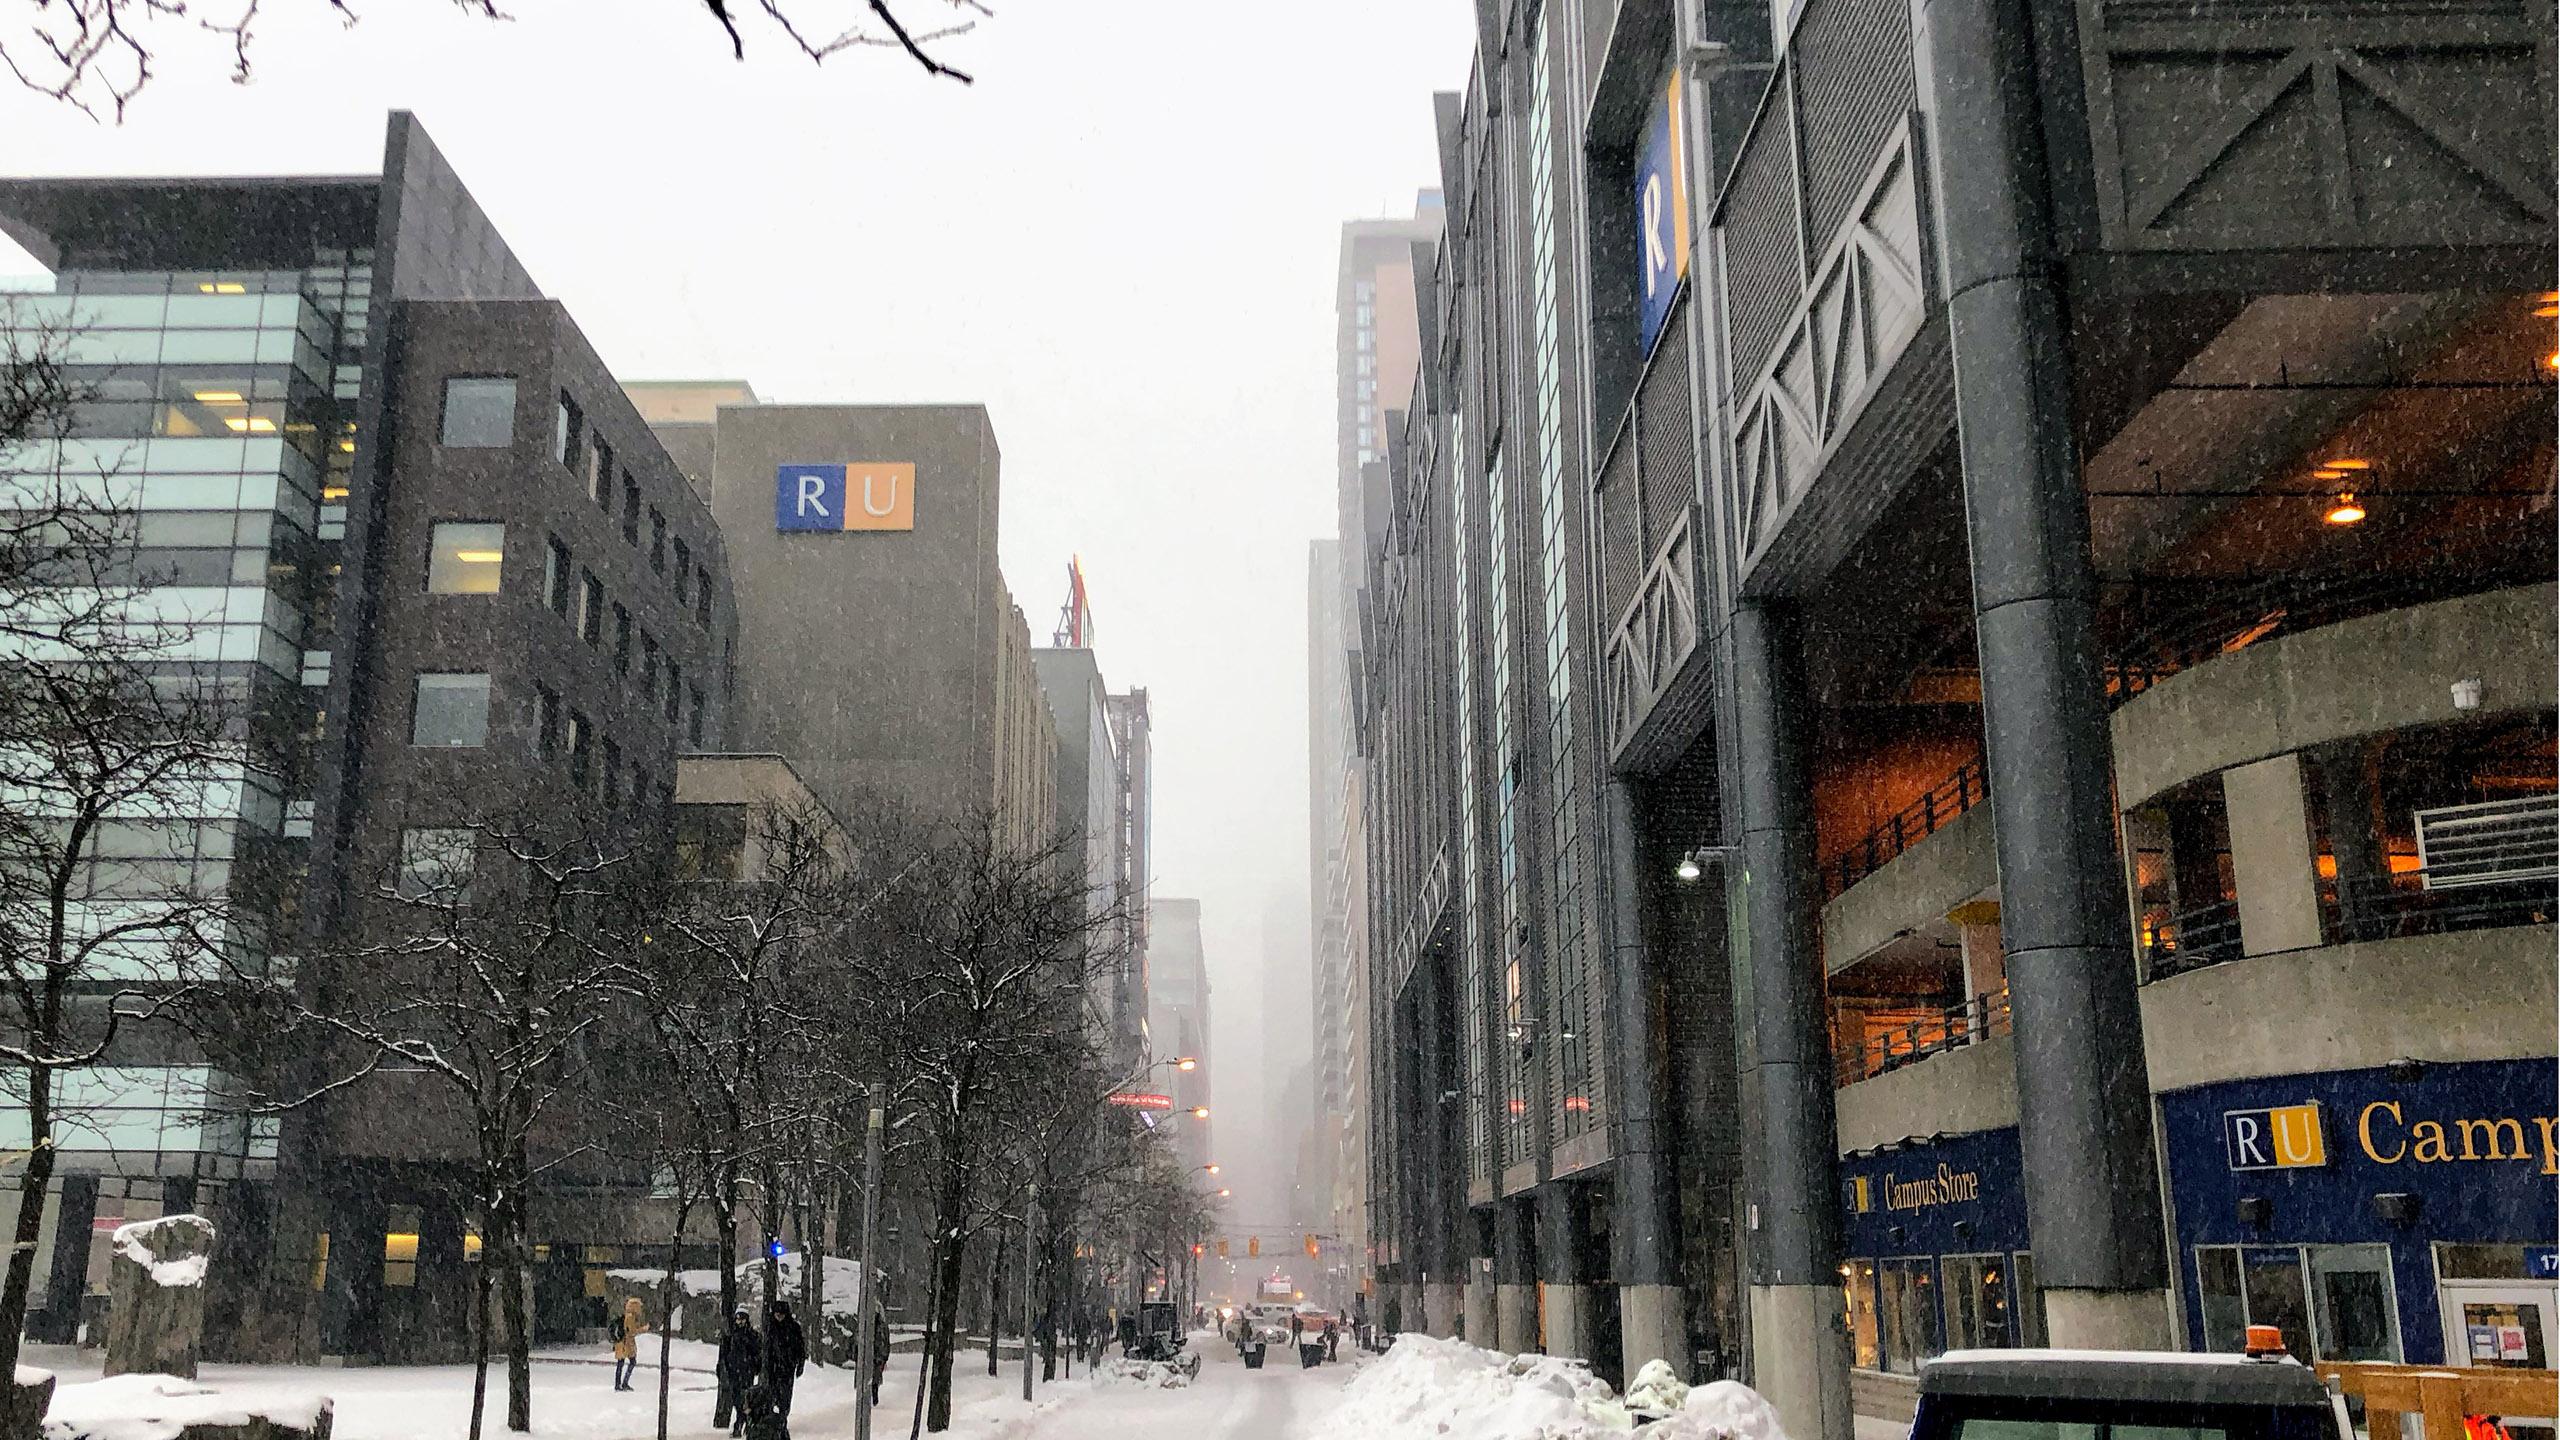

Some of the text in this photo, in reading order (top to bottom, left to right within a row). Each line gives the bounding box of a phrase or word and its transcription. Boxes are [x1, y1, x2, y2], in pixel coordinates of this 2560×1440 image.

[797, 474, 898, 518] RU
[2235, 1100, 2559, 1175] RU Camp
[1884, 1171, 1938, 1217] Campus
[1938, 1162, 1979, 1204] Store
